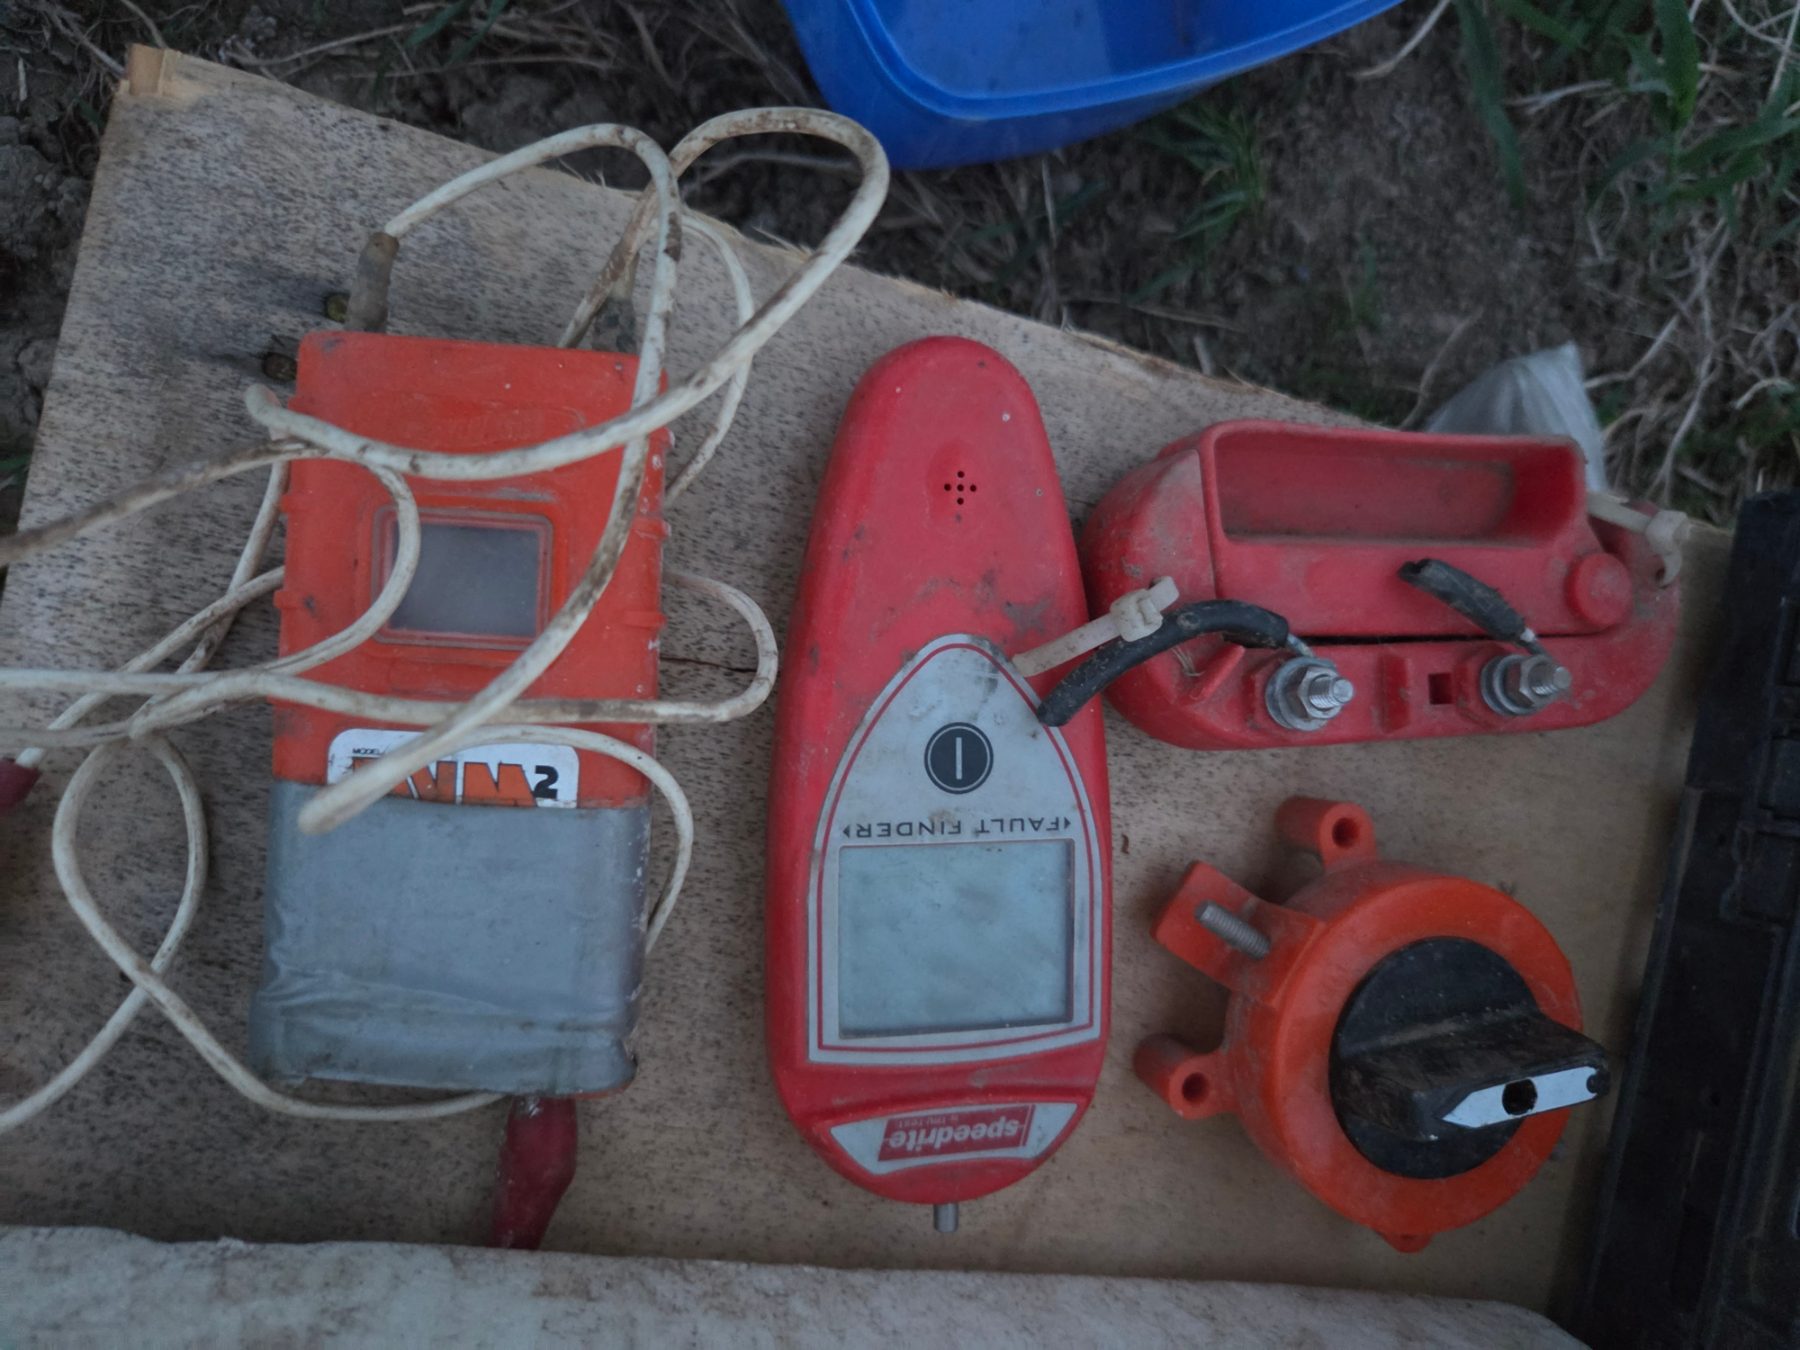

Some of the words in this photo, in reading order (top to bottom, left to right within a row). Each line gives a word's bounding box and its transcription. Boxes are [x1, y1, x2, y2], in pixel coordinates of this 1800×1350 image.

[856, 819, 961, 838] FINDER
[977, 816, 1060, 835] FAULT
[889, 1115, 1020, 1152] speedrite
